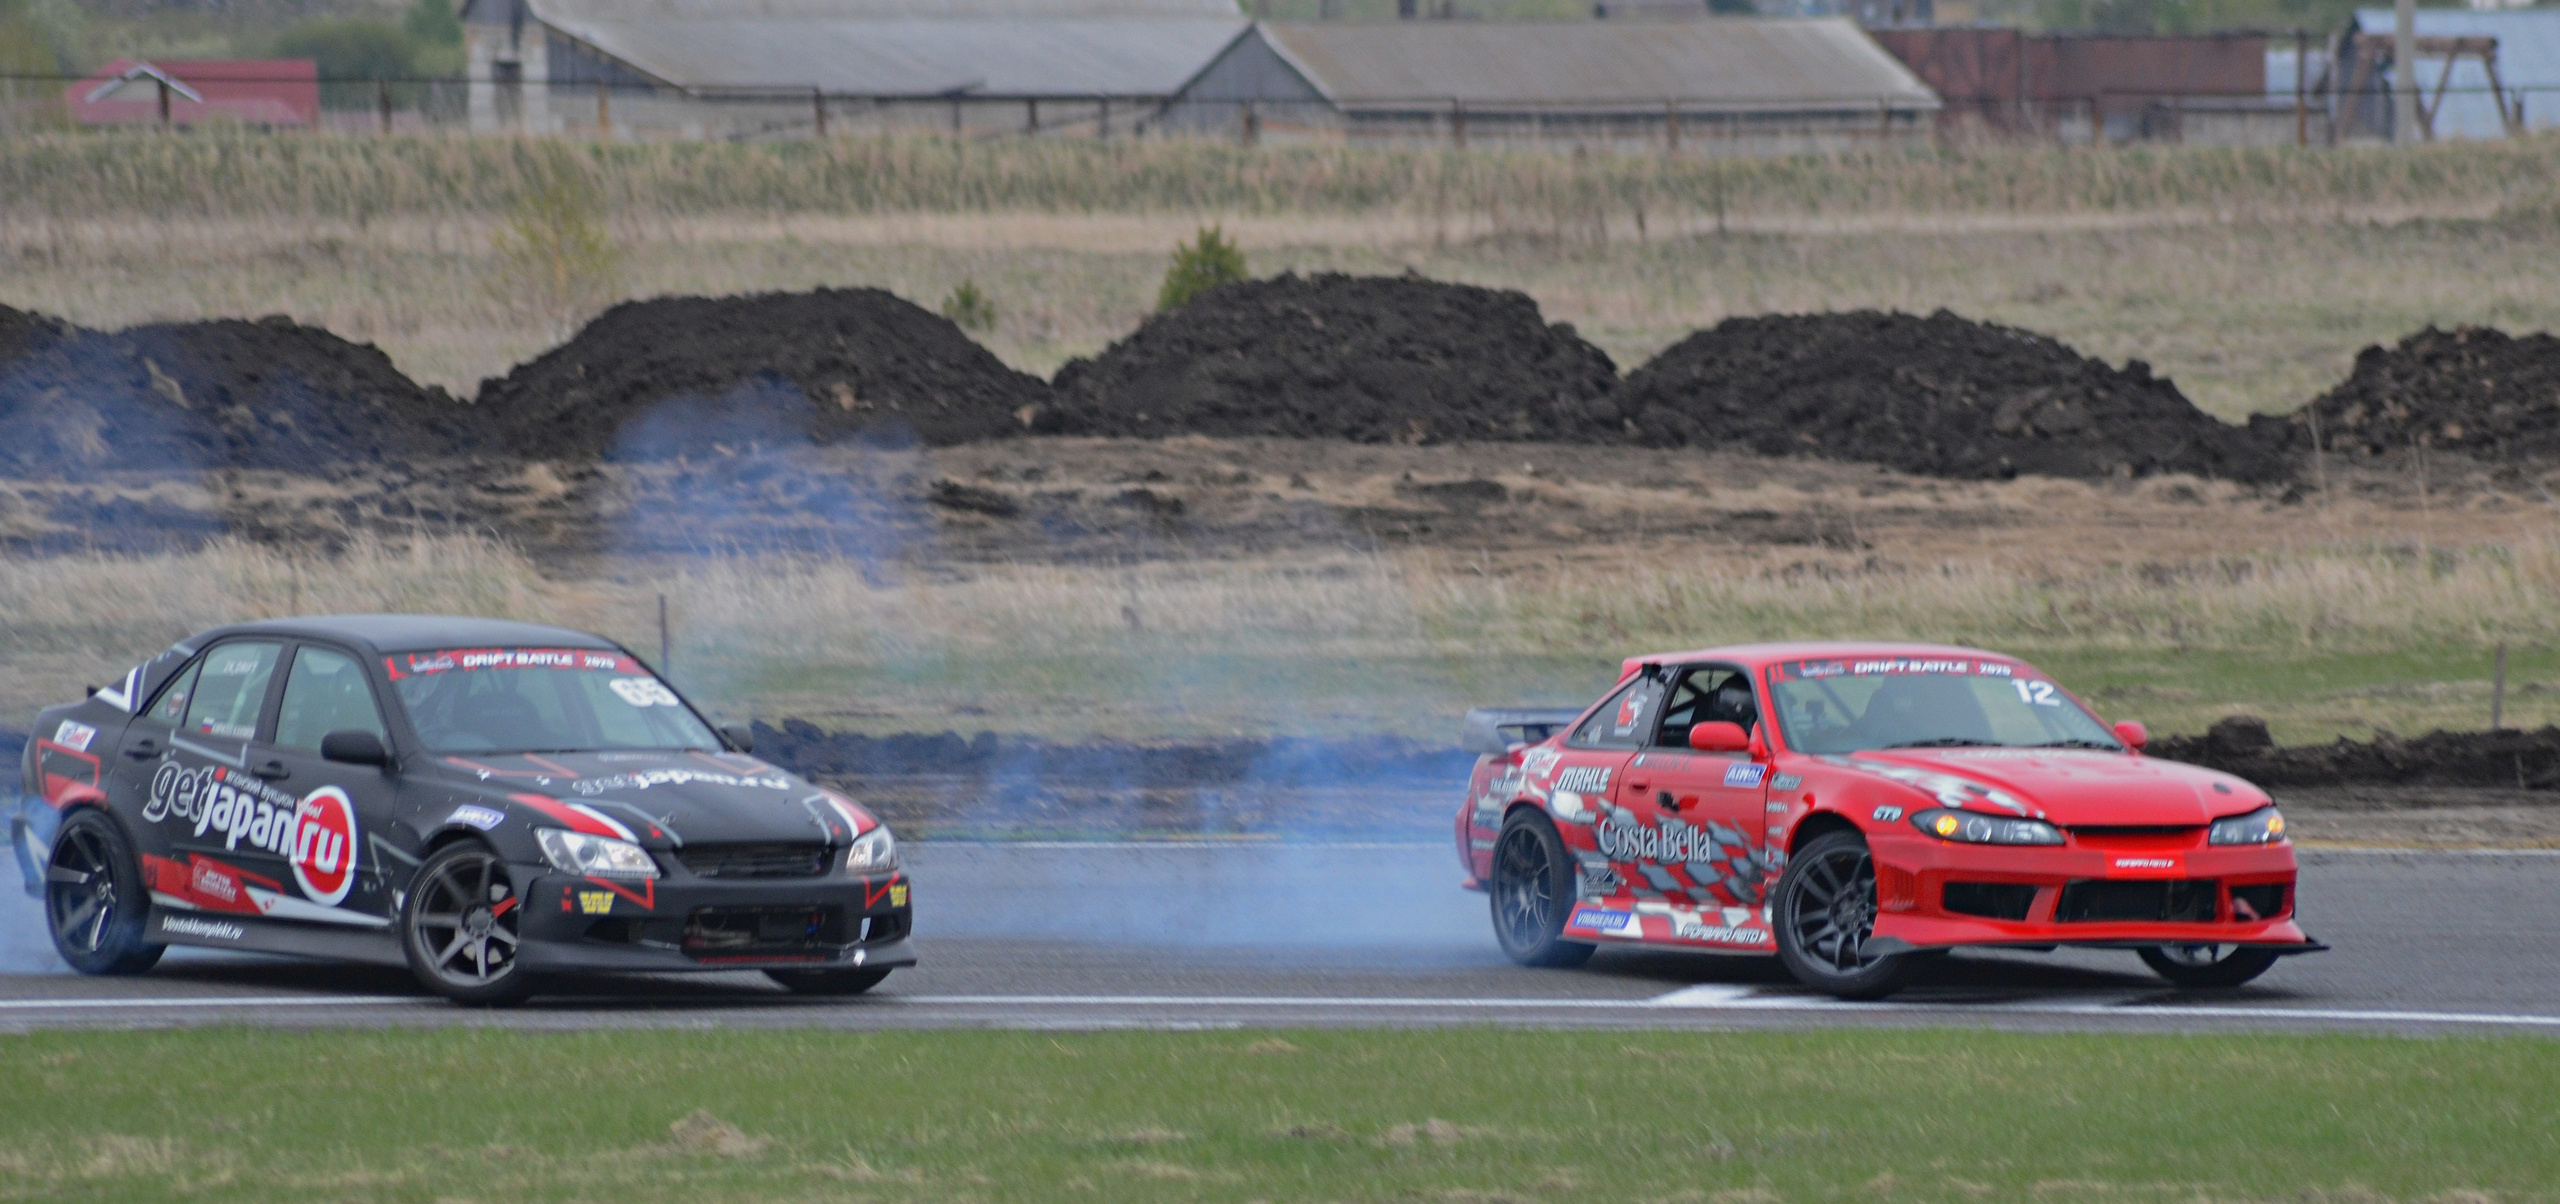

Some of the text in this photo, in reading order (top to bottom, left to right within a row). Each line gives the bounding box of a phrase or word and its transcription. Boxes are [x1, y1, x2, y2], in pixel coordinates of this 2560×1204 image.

[463, 653, 515, 667] DRIFT
[516, 653, 573, 666] BATTLE
[1854, 661, 1907, 673] DRIFT
[1909, 661, 1968, 673] BATTLE
[2011, 679, 2060, 707] 12
[1552, 767, 1612, 793] MAHLE
[1599, 817, 1711, 864] Costa Bella
